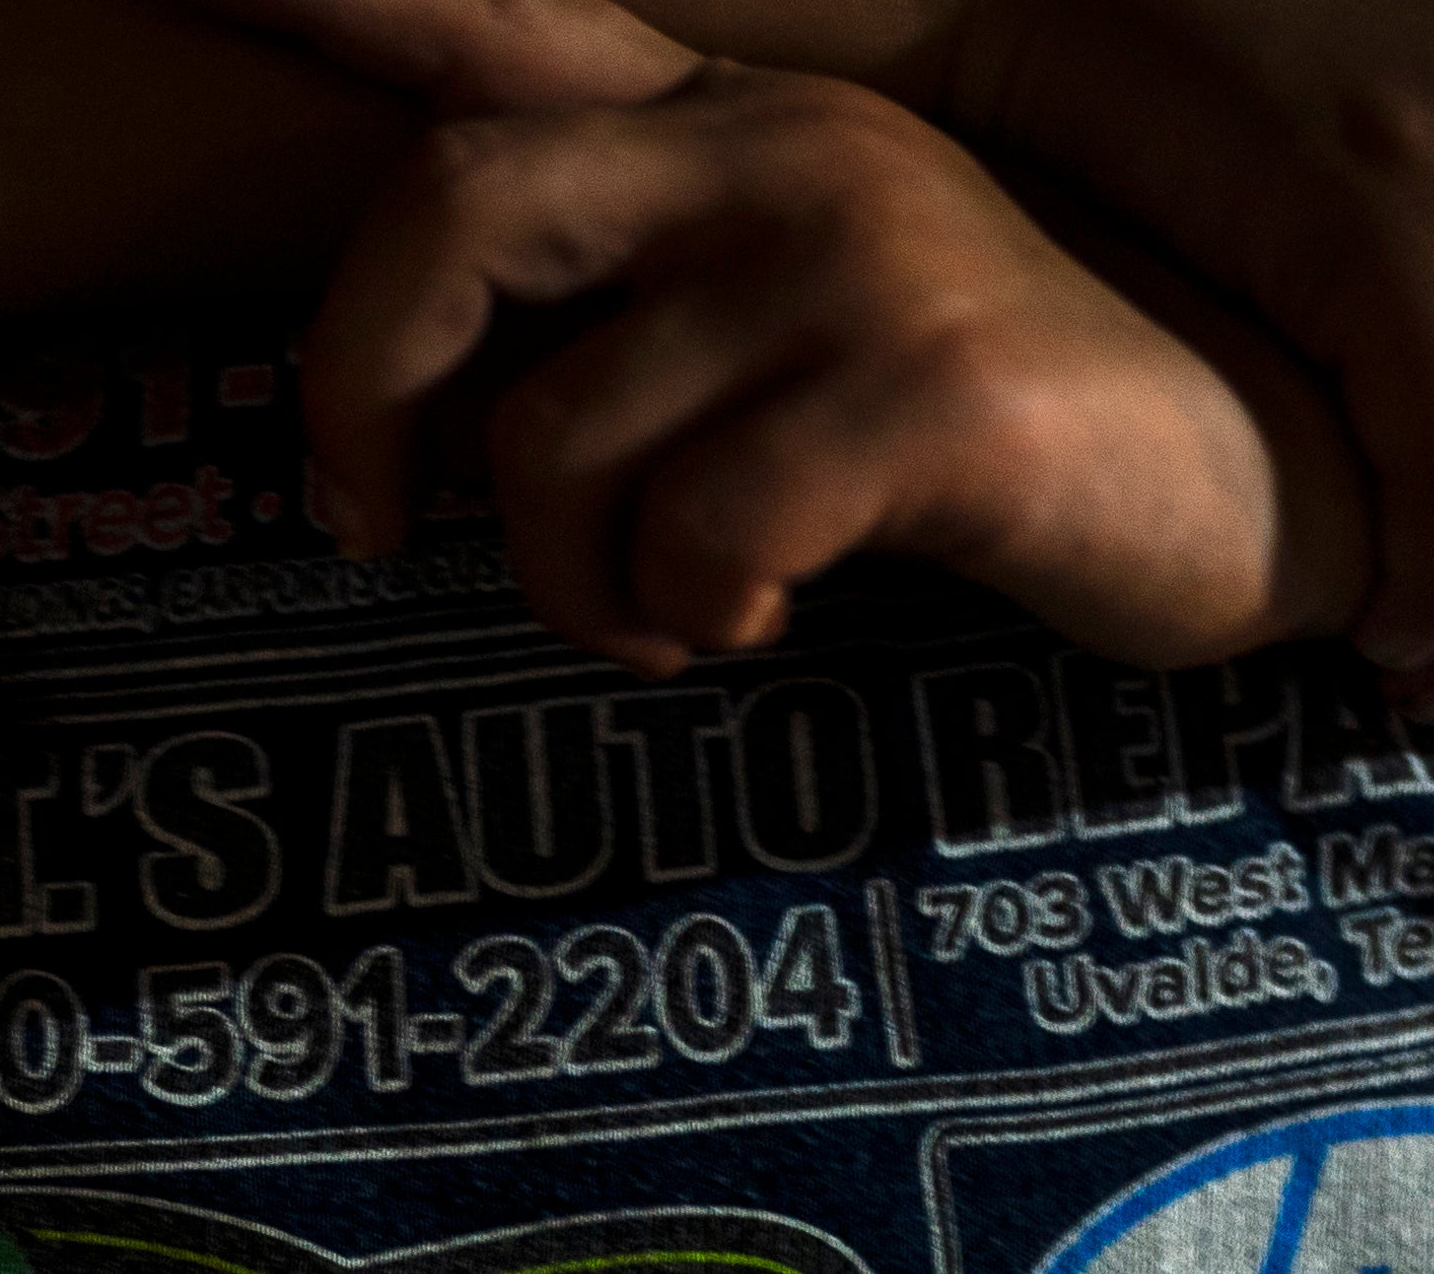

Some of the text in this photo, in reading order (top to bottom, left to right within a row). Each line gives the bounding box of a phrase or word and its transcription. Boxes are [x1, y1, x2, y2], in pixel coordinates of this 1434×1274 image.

[320, 671, 882, 920] AUTO
[916, 868, 1094, 965] 703
[1094, 837, 1312, 941] West
[1020, 925, 1340, 1035] Uvalde,
